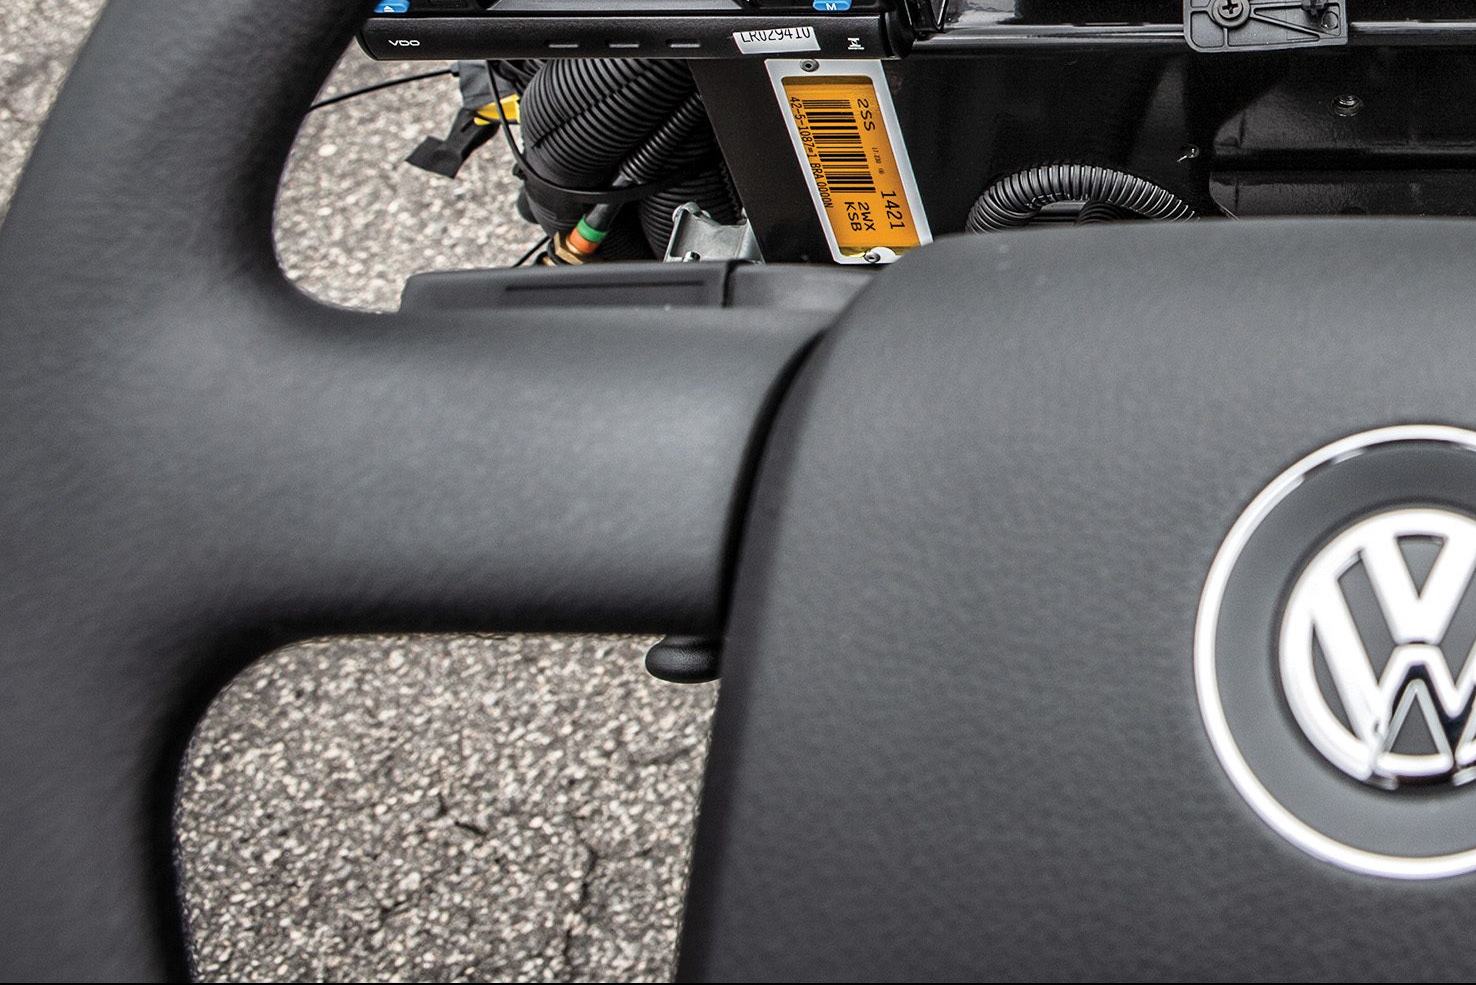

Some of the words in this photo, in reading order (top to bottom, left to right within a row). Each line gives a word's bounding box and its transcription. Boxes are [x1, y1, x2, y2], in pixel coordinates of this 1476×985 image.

[826, 3, 837, 11] M
[857, 98, 876, 132] 2SS
[844, 201, 863, 232] KSB
[857, 201, 876, 232] 2WX
[880, 190, 906, 230] 1421
